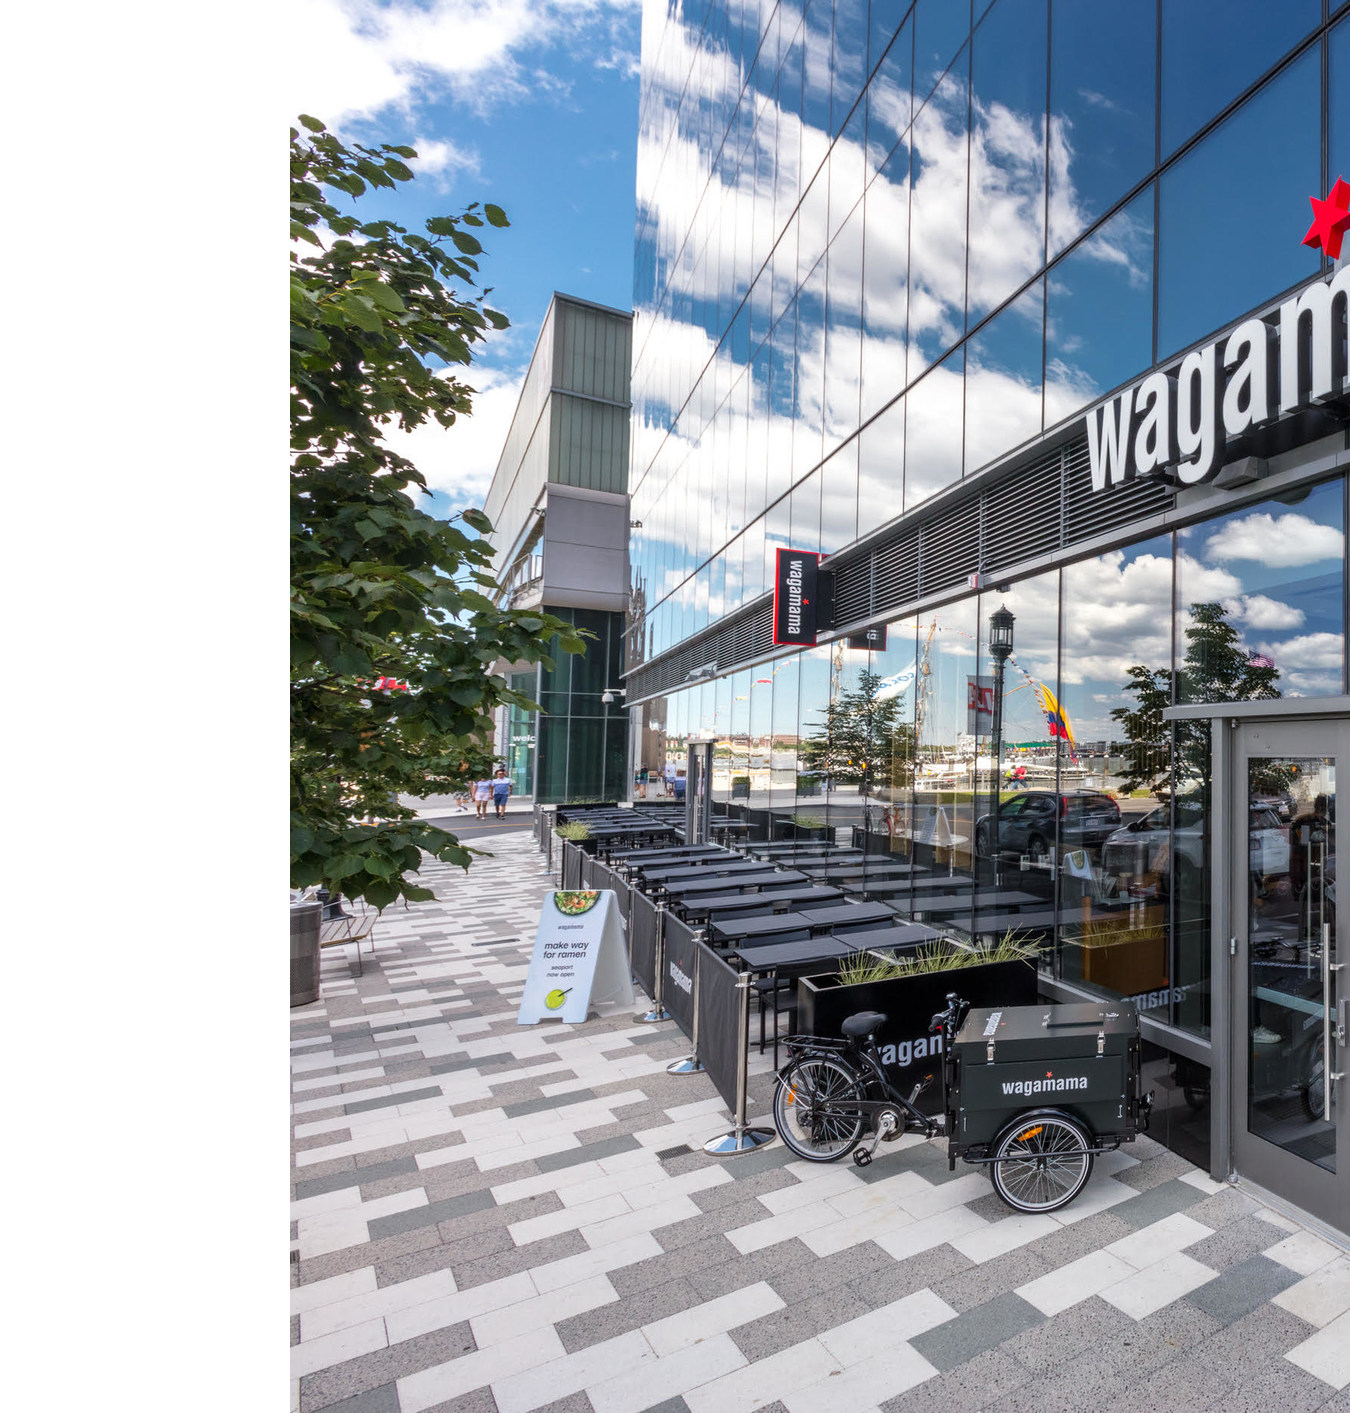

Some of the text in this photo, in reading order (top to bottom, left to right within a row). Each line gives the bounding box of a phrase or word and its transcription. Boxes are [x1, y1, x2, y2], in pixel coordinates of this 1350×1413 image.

[787, 561, 803, 635] wagamama
[545, 941, 589, 950] make way
[544, 951, 556, 959] for
[1002, 1077, 1088, 1096] wagamama
